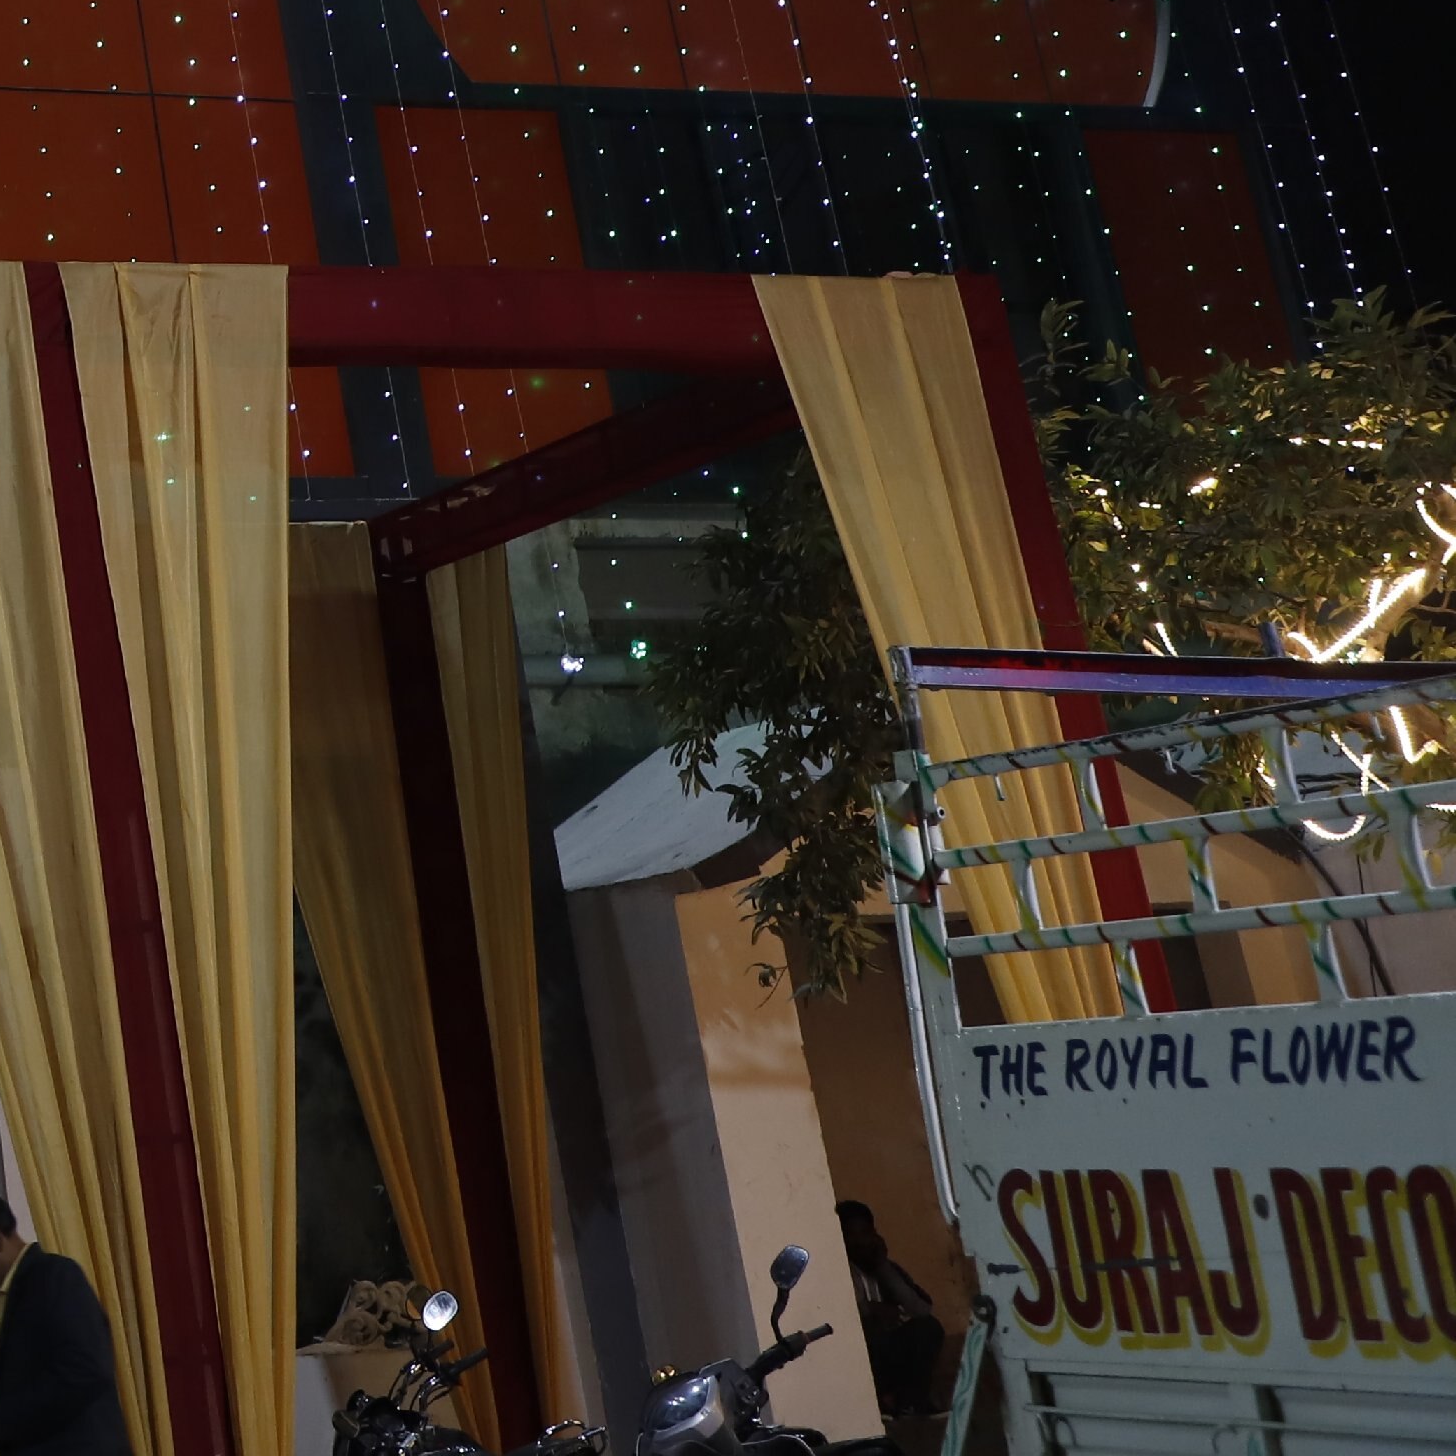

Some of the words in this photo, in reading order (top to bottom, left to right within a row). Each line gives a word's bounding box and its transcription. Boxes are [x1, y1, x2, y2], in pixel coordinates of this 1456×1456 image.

[973, 1041, 1049, 1099] THE
[1065, 1032, 1209, 1092] ROYAL
[1230, 1016, 1423, 1085] FLOWER
